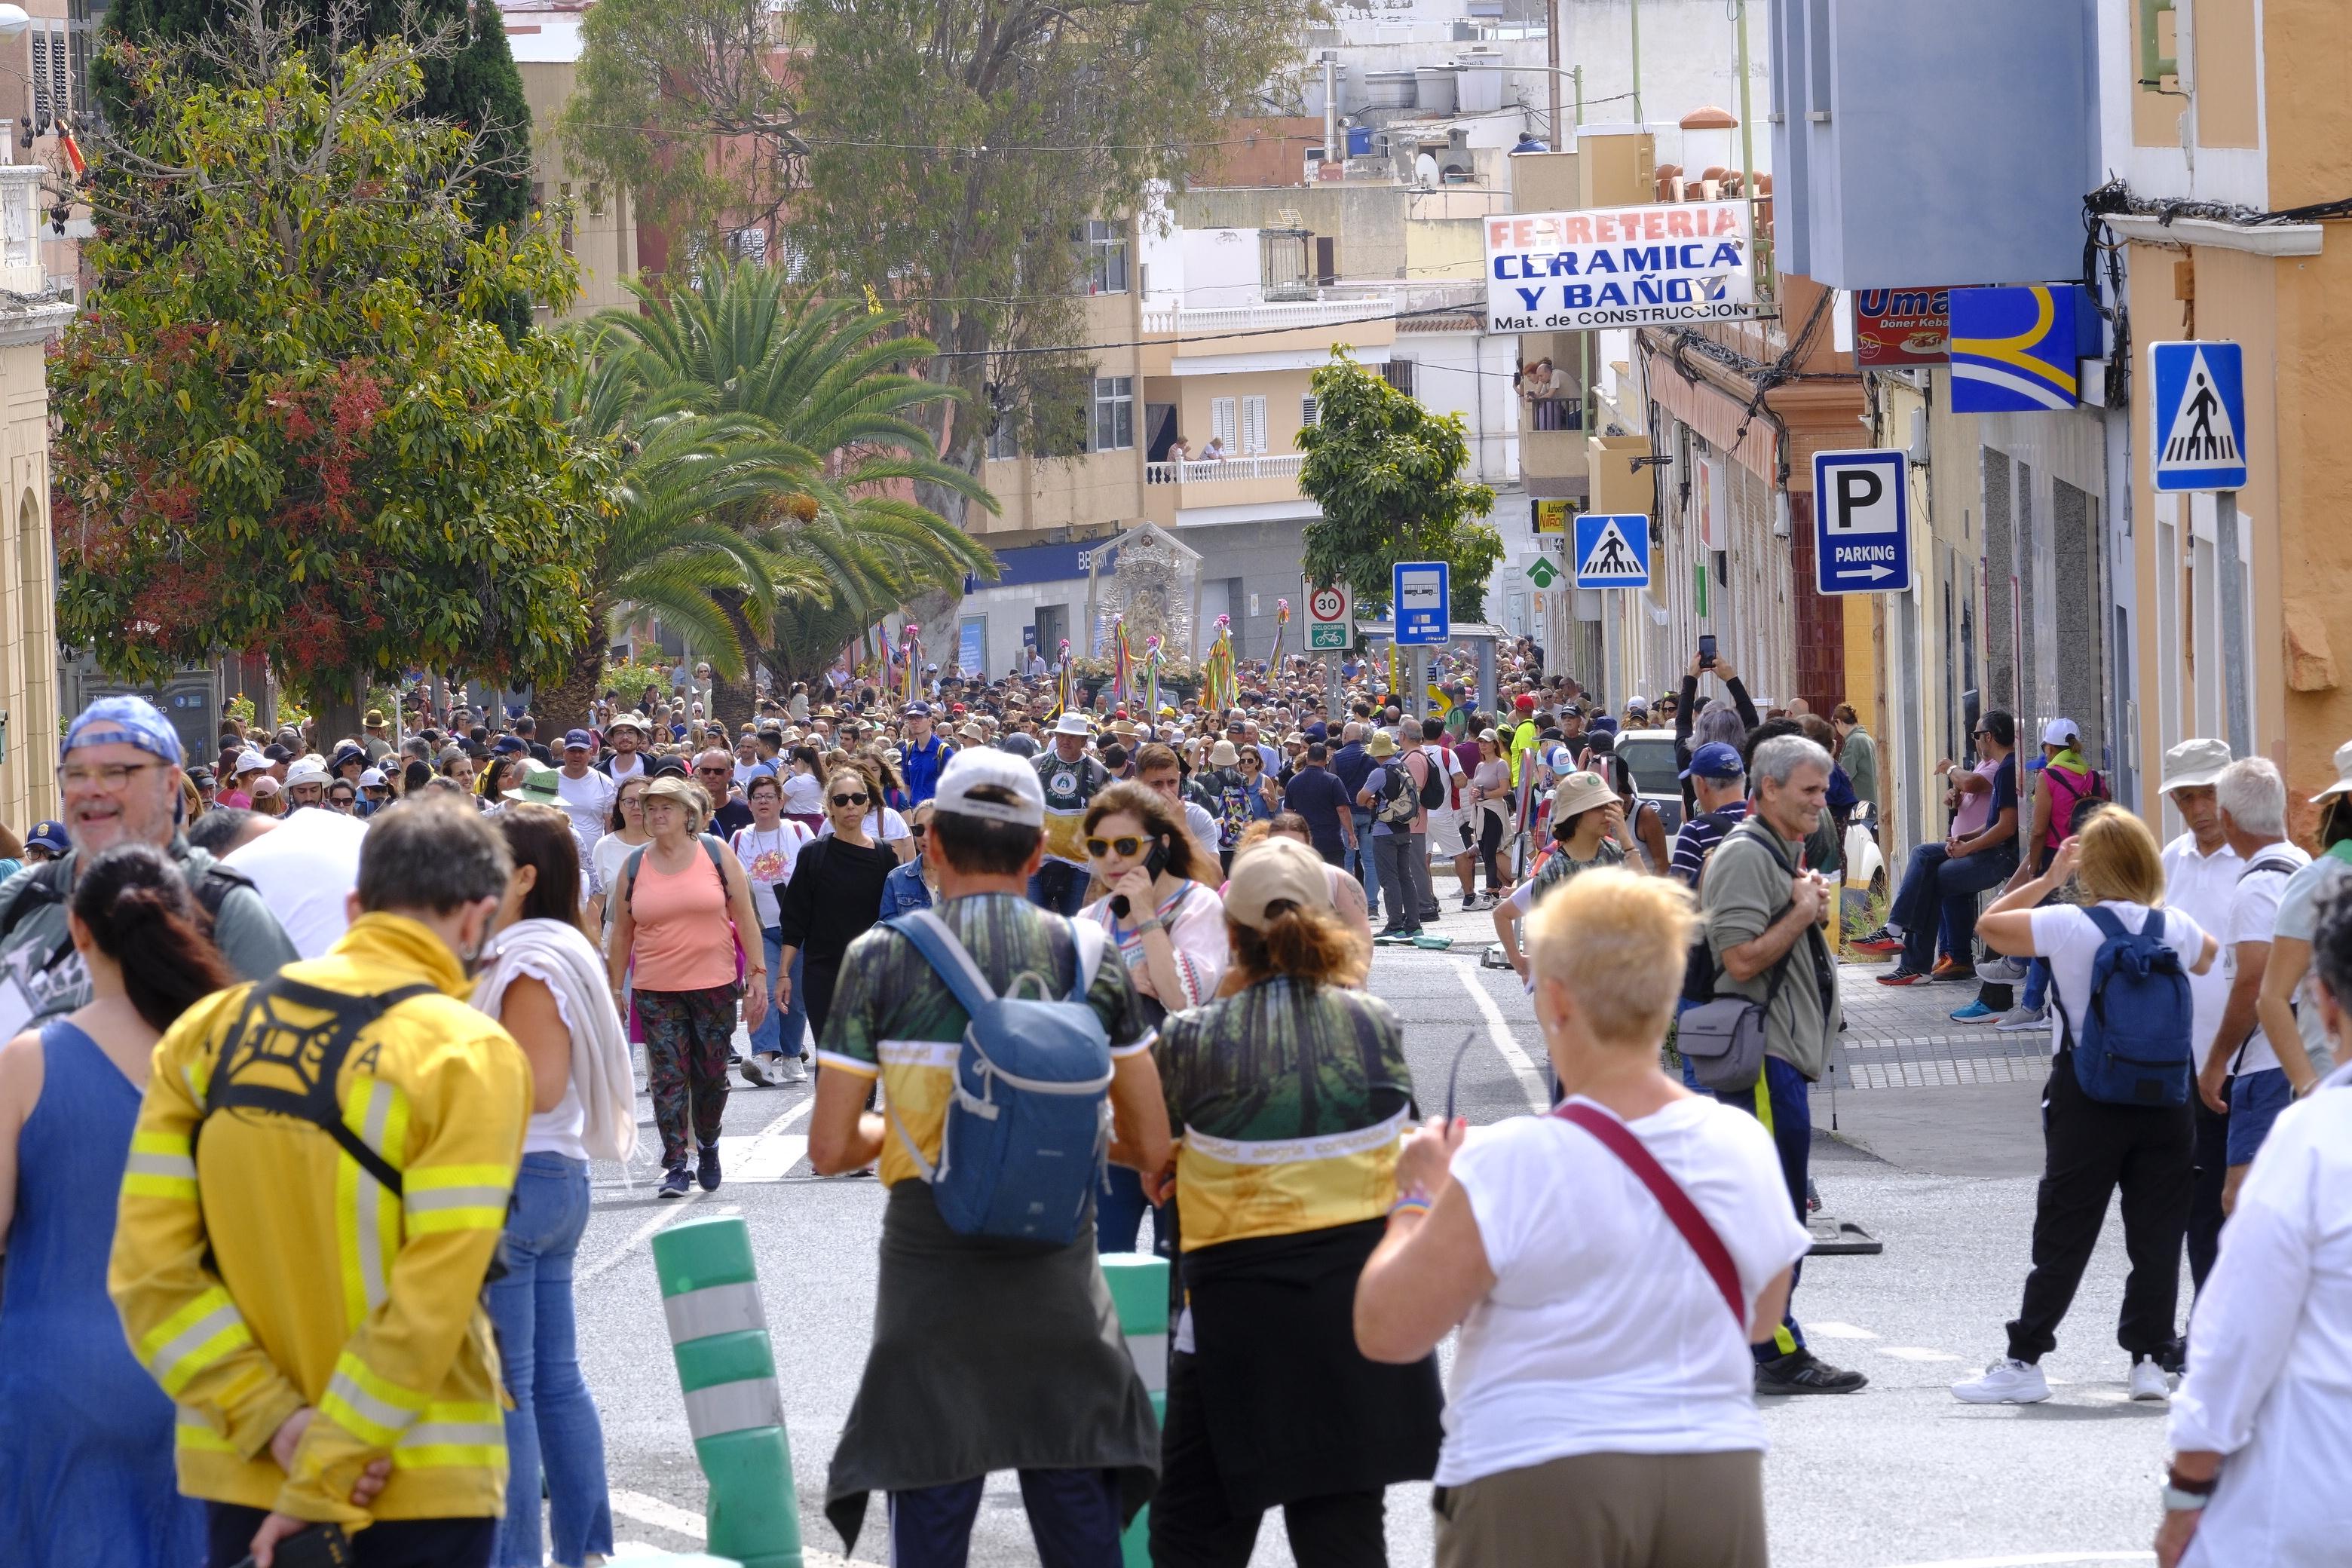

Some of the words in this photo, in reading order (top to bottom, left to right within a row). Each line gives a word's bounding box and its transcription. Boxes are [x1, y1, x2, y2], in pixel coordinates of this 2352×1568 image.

[1514, 286, 1547, 311] Y
[1495, 316, 1539, 329] Mat.
[1545, 314, 1570, 326] de
[1578, 302, 1748, 325] CONSTRUCCION
[1879, 318, 1916, 329] Döner
[1836, 470, 1883, 528] P
[1836, 545, 1895, 562] PARKING
[1318, 599, 1337, 610] 30
